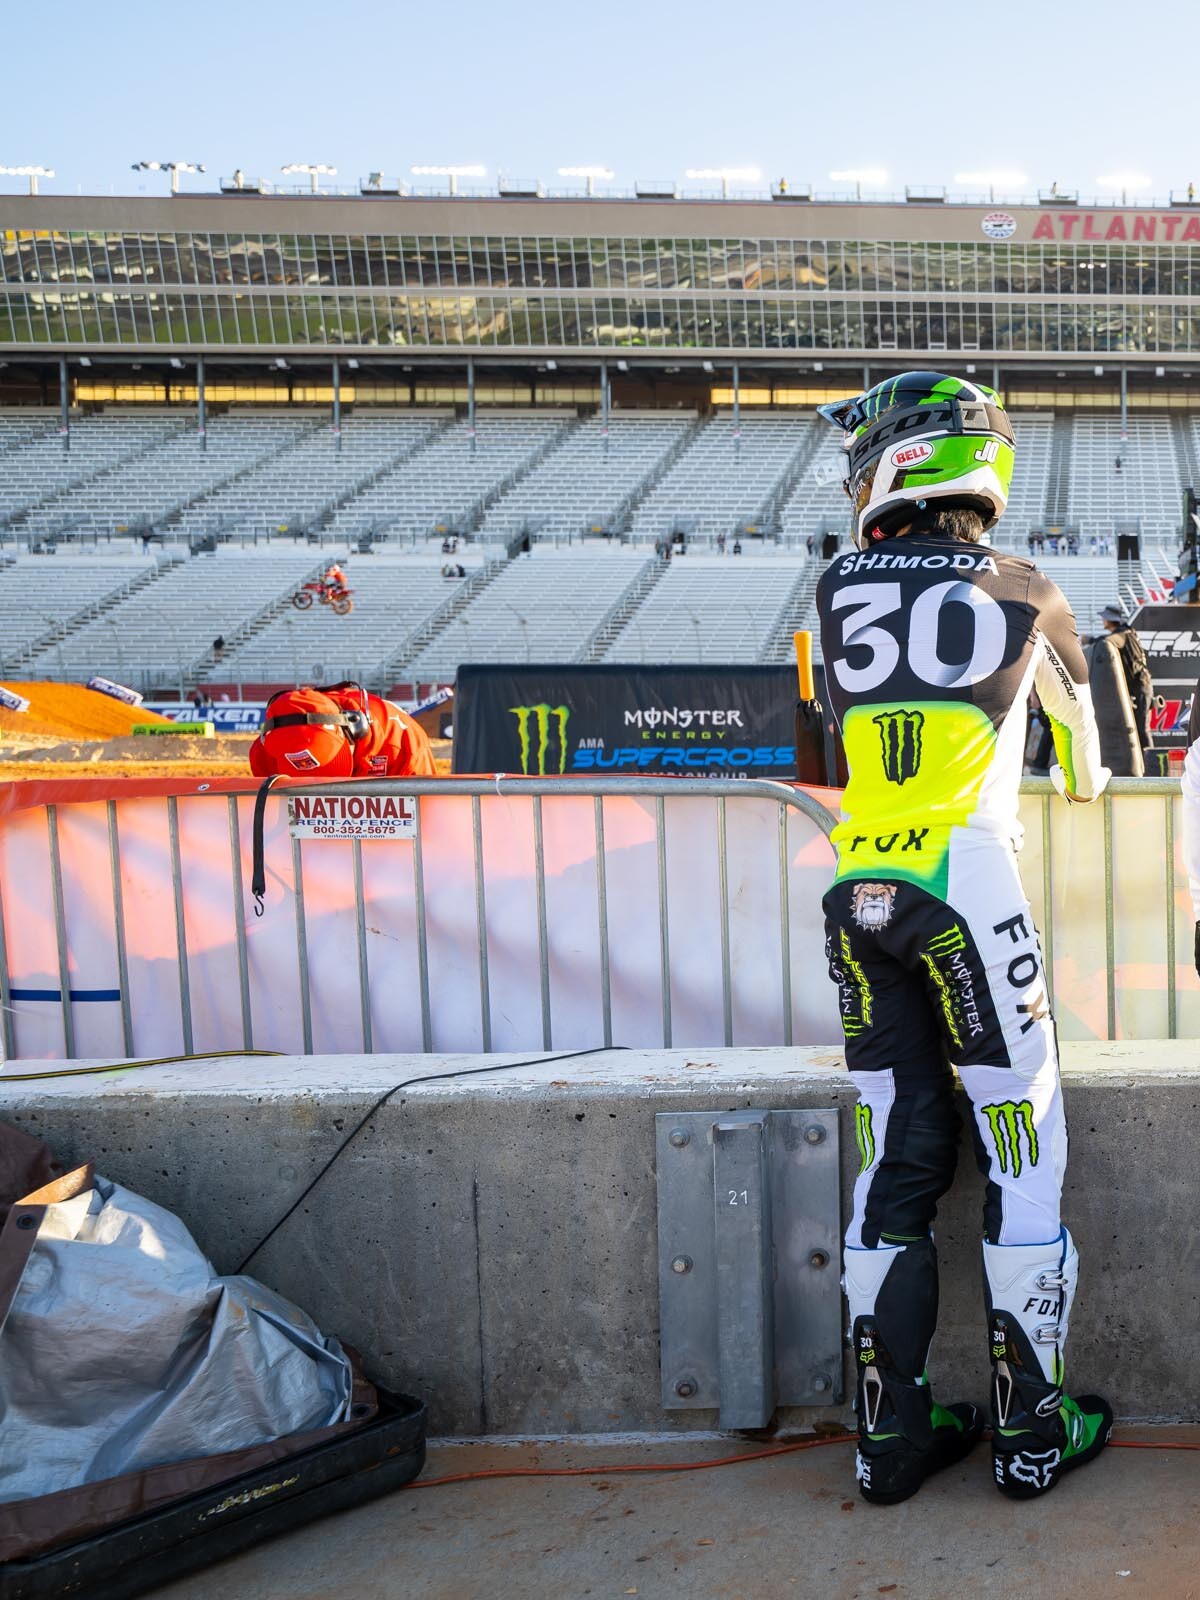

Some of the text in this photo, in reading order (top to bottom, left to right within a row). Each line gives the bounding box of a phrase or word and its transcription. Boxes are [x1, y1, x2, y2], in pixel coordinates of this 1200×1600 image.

[1032, 213, 1200, 243] ATLANTA
[895, 446, 929, 465] BELL
[839, 553, 1000, 577] SHIMODA
[830, 580, 1007, 693] 30
[1044, 644, 1078, 702] PRO CIRCUIT
[624, 706, 744, 729] MONSTER
[578, 738, 605, 749] AMA
[641, 730, 727, 740] ENERGY
[571, 746, 797, 768] SUPERCROSS
[294, 797, 412, 820] NATIONAL
[296, 819, 412, 827] RENT-A-FENCE
[313, 826, 396, 834] 800-352-5675
[992, 913, 1049, 1035] FOX
[949, 952, 984, 1037] MONSTER
[728, 1190, 750, 1206] 21
[1023, 1297, 1061, 1318] FOX
[859, 1336, 873, 1348] 30
[993, 1330, 1006, 1343] 30
[862, 1462, 872, 1490] FOX
[995, 1456, 1005, 1485] FOX
